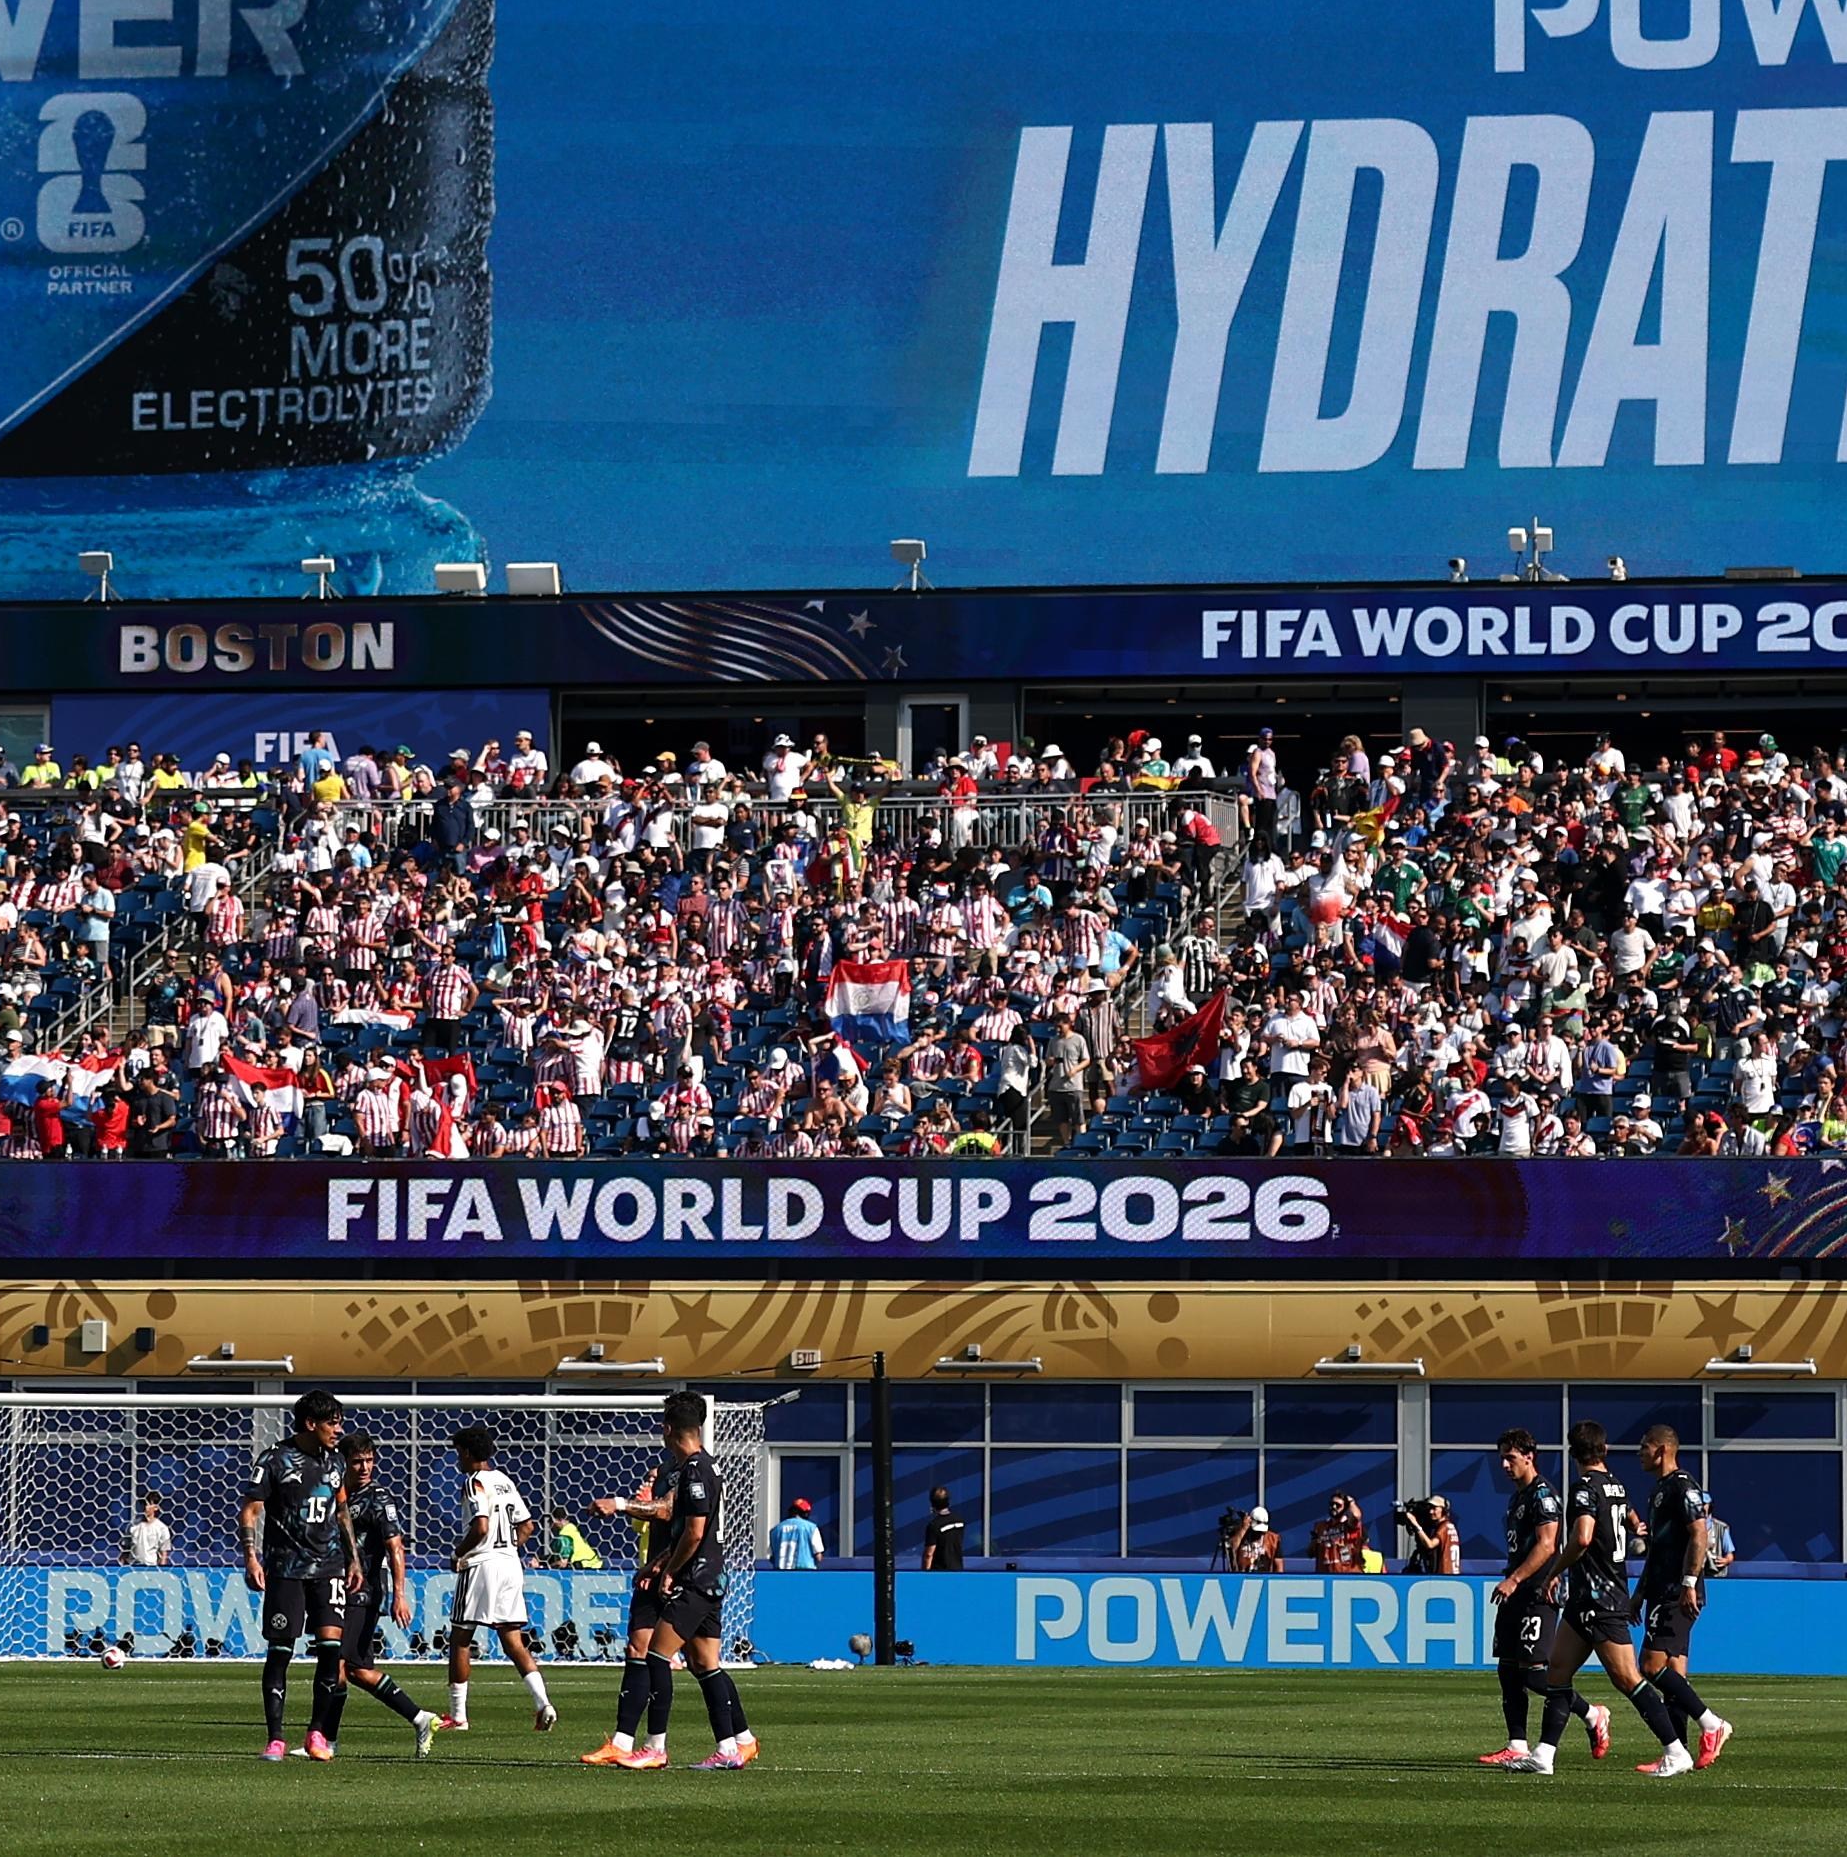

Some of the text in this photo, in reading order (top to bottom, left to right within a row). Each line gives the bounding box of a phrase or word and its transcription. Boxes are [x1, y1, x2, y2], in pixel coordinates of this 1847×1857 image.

[67, 221, 117, 240] FIFA
[47, 281, 133, 295] PARTNER
[49, 264, 131, 279] OFFICIAL
[286, 234, 432, 317] 50%
[290, 321, 430, 380] MORE
[132, 378, 433, 433] ELECTROLYTES
[120, 621, 394, 674] BOSTON
[1202, 609, 1341, 659] FIFA
[1352, 606, 1595, 657] WORLD
[1609, 603, 1743, 653] CUP
[327, 1175, 1331, 1243] FIFA WORLD CUP 2026
[306, 1496, 327, 1523] 15
[48, 1570, 631, 1657] POWADE
[328, 1577, 346, 1606] 15
[1016, 1577, 1600, 1667] POWERA
[1520, 1616, 1542, 1641] 23
